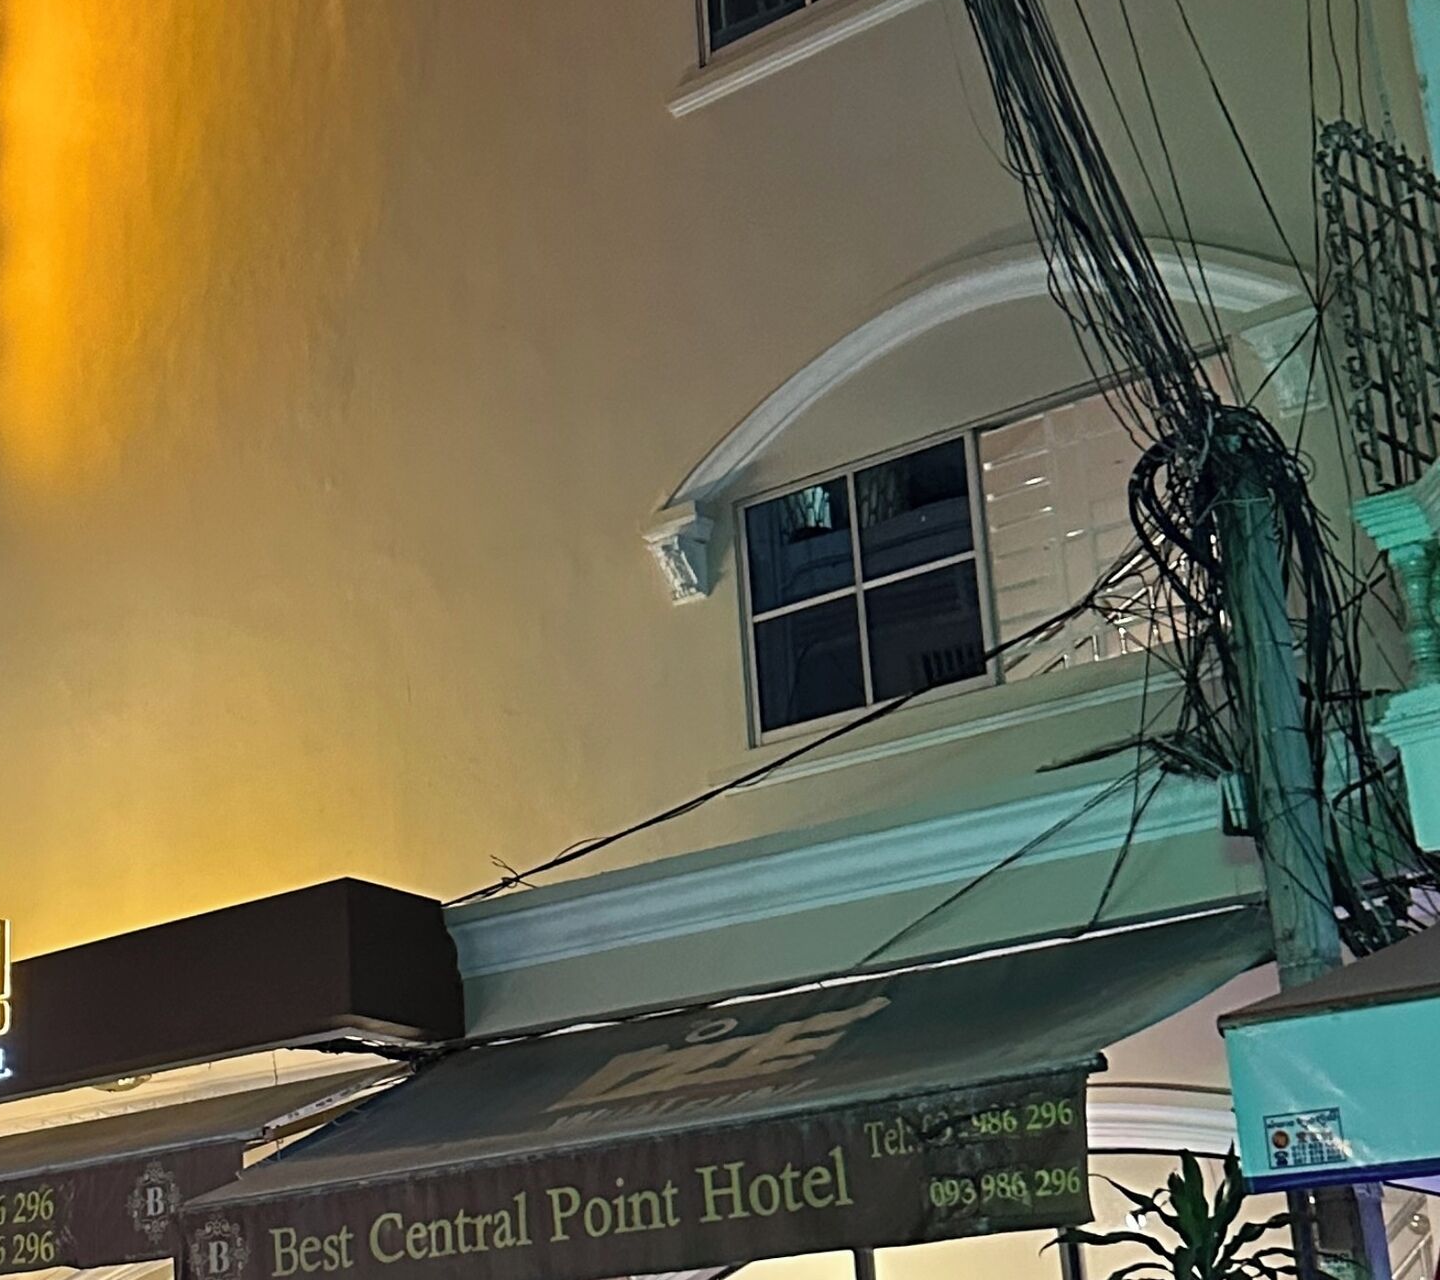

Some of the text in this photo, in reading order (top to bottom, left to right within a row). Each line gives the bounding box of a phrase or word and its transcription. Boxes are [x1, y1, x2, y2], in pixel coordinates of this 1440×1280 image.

[1026, 1098, 1073, 1131] 296
[146, 1186, 165, 1217] B
[929, 1166, 1082, 1208] 093 986 296
[12, 1188, 55, 1224] 296
[269, 1145, 855, 1278] Best Central Point Hotel
[11, 1230, 55, 1265] 296
[208, 1240, 230, 1273] B
